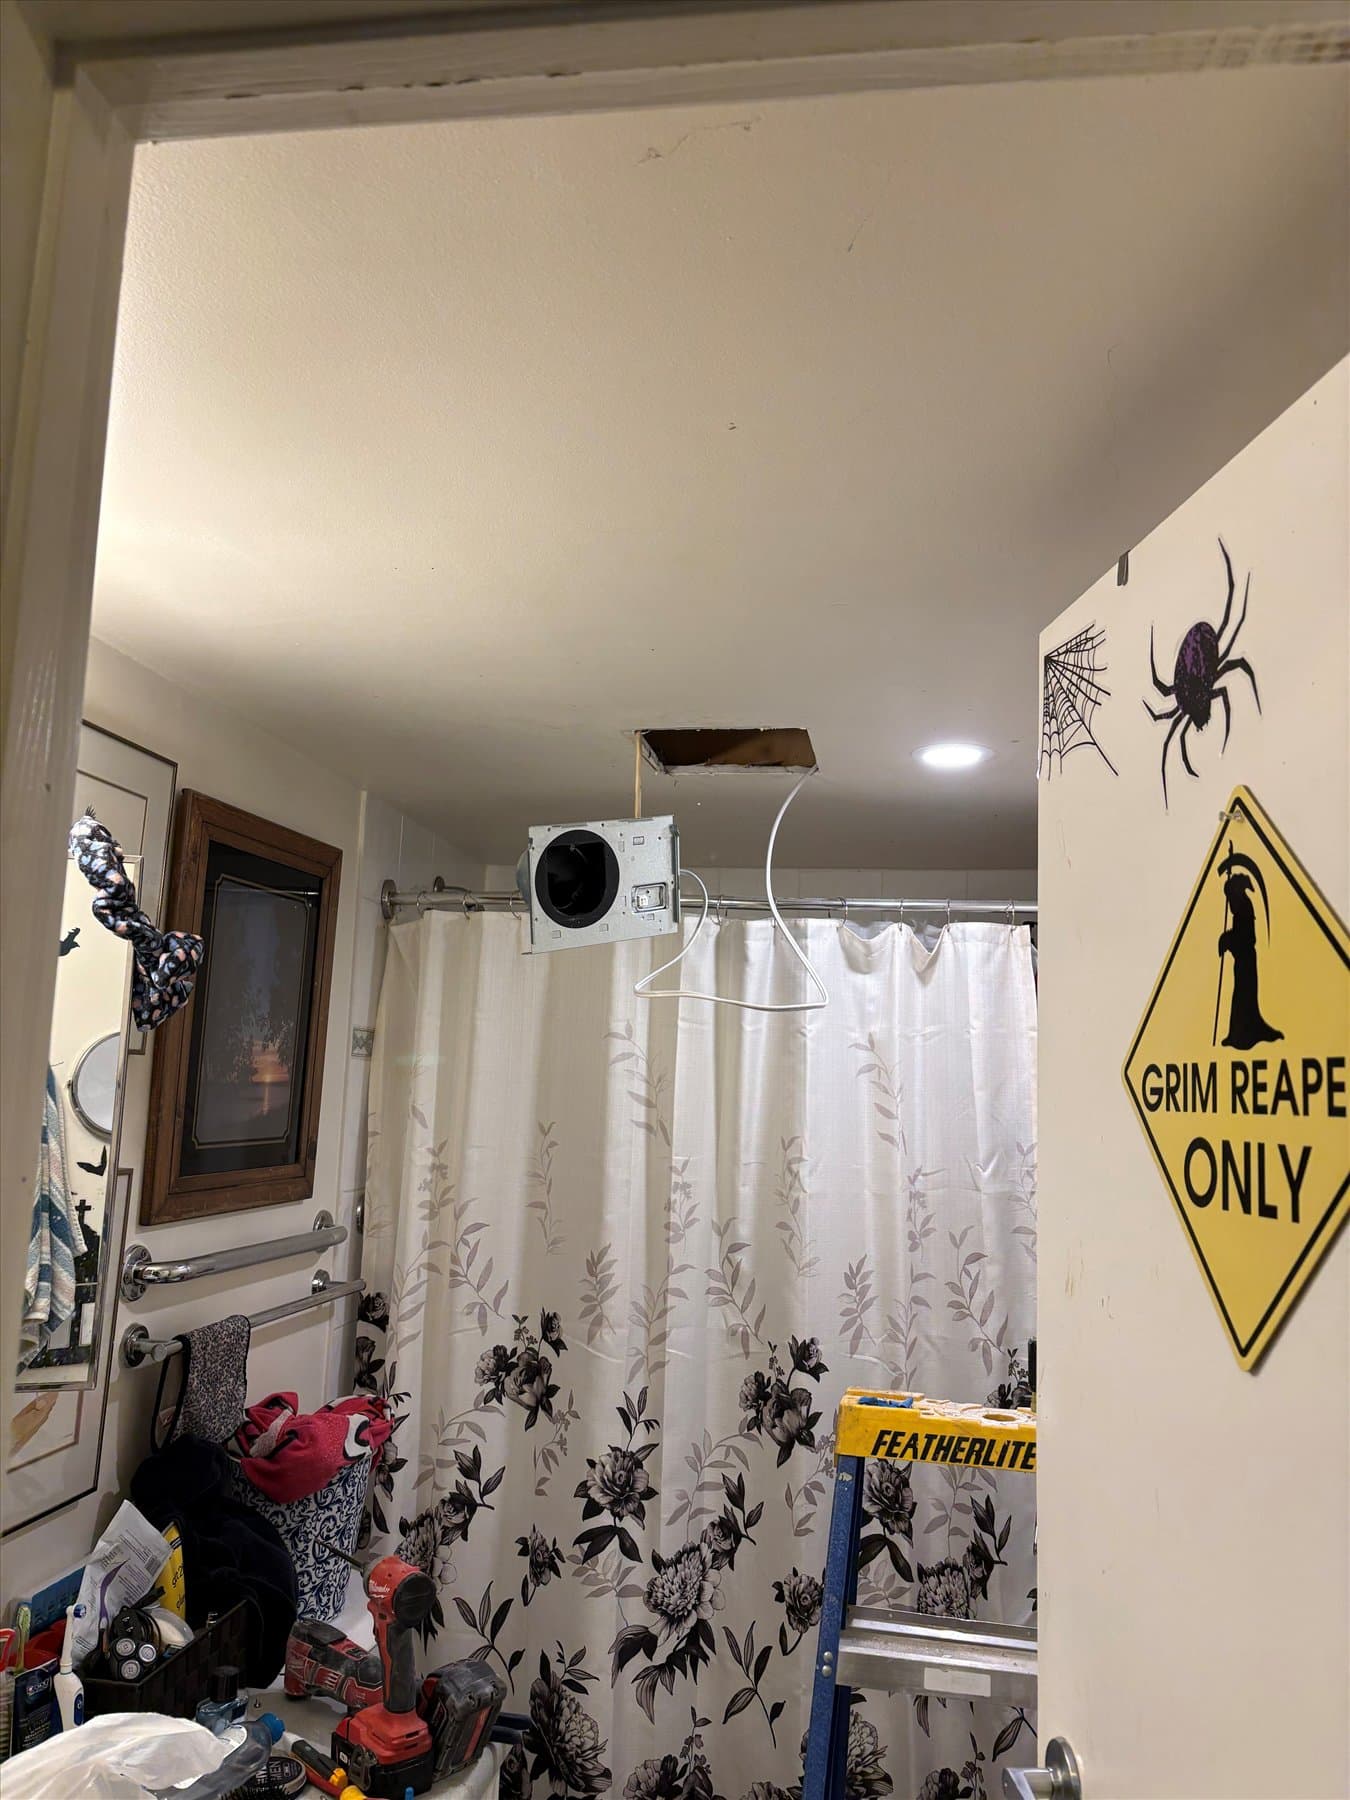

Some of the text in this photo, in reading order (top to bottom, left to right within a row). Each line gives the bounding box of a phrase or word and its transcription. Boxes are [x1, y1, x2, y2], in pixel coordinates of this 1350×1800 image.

[1142, 1056, 1347, 1118] GRIM REAPE
[1184, 1136, 1313, 1224] ONLY
[870, 1429, 1037, 1470] FEATHERLITE
